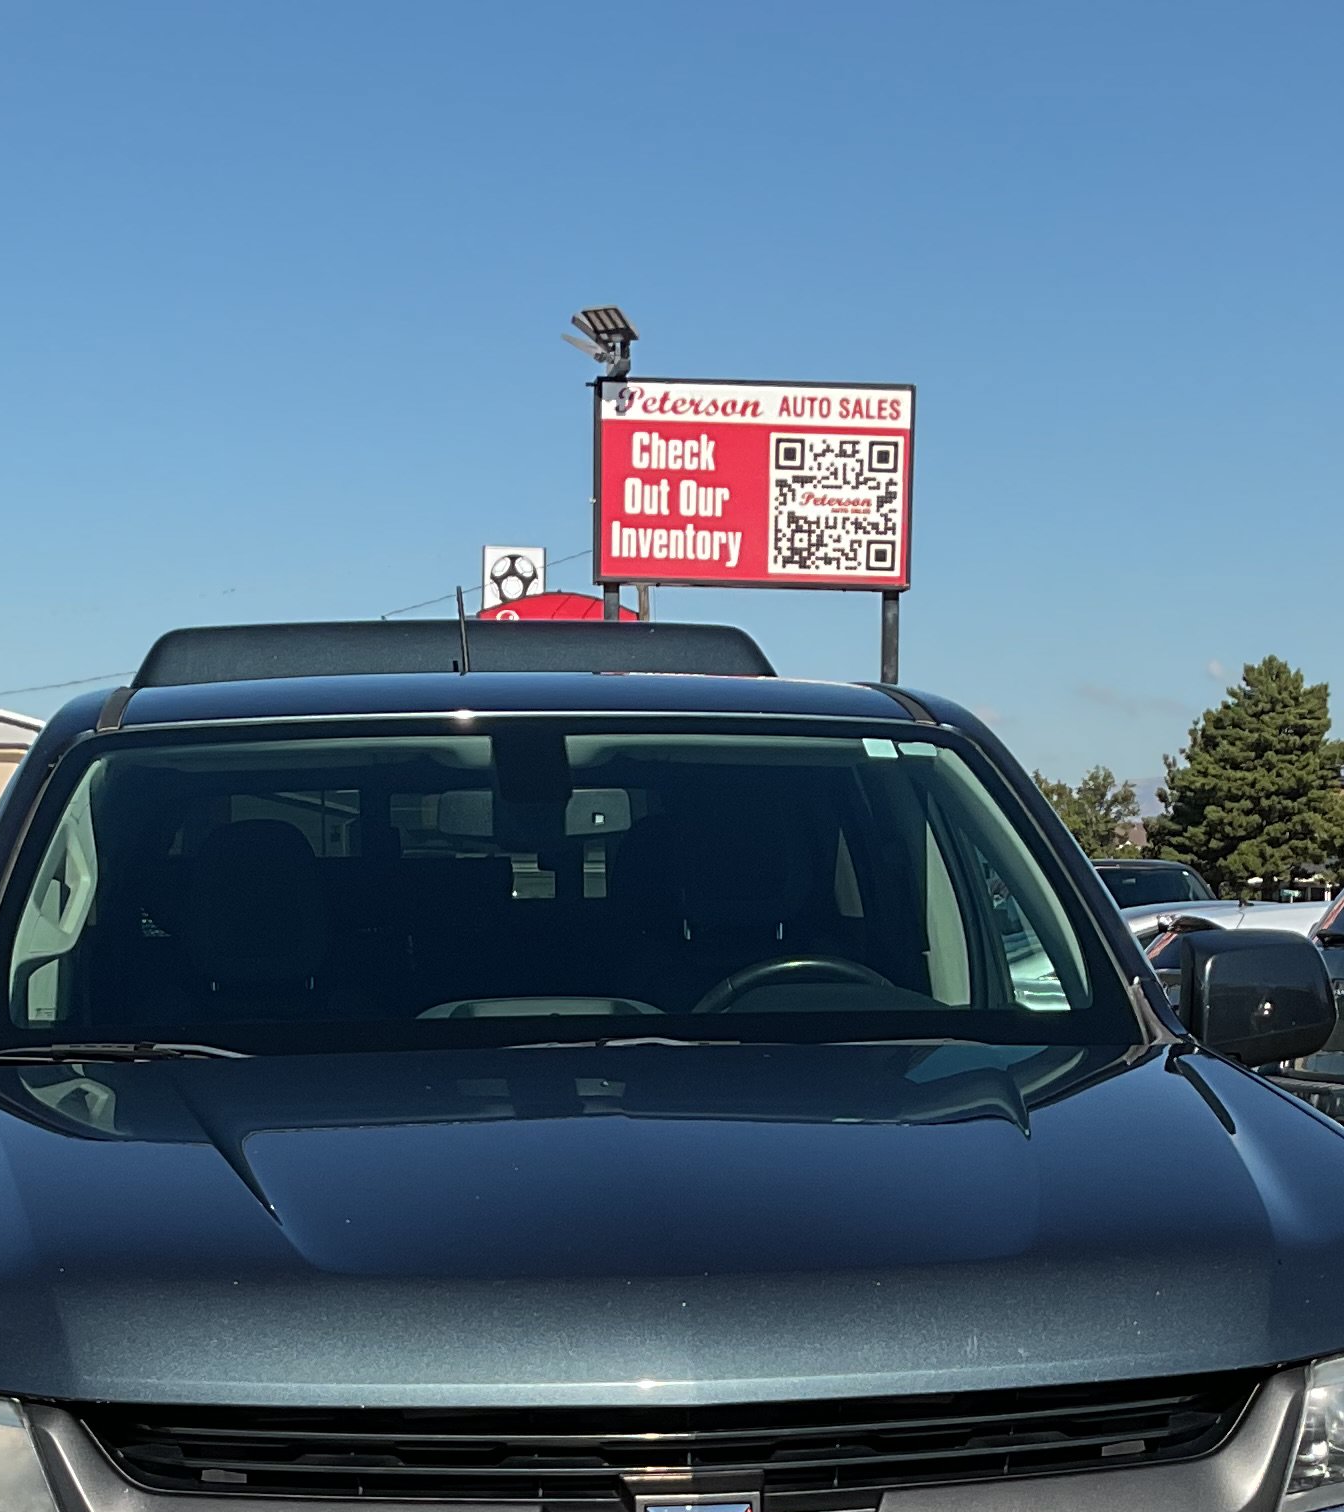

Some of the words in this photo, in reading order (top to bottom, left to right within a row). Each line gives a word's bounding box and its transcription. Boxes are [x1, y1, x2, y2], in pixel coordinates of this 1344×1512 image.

[614, 386, 763, 418] Peterson
[778, 395, 831, 418] AUTO
[838, 397, 903, 420] SALES
[632, 431, 715, 471] Check
[624, 477, 670, 516] Out
[679, 479, 730, 517] Our
[799, 492, 872, 506] Peterson
[611, 520, 742, 568] Inventory
